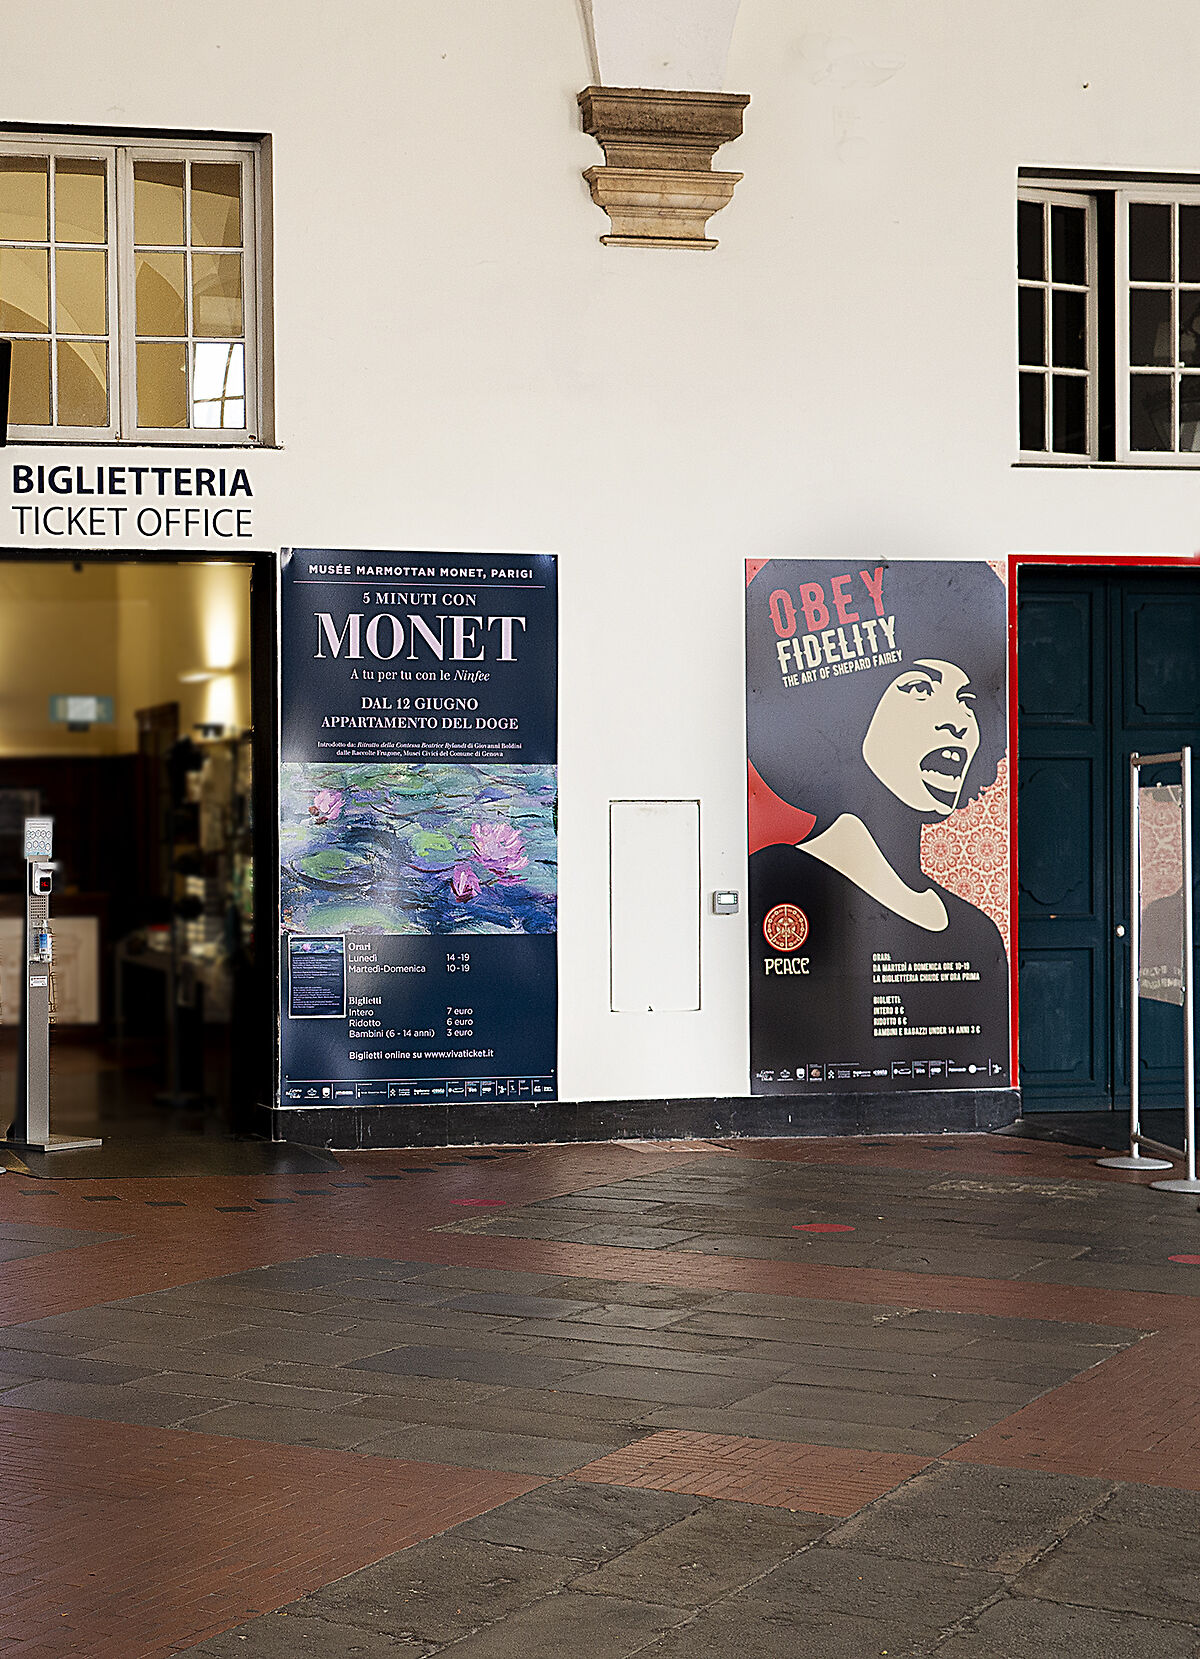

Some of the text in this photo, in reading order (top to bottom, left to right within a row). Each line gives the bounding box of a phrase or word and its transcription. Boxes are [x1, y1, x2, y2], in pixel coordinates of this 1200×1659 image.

[12, 464, 254, 497] BIGLIETTERIA
[11, 505, 253, 538] TICKET OFFICE
[308, 564, 533, 579] MUSÉE MARMOTTAN MONET, PARIGI
[363, 592, 477, 606] 5 MINUTI CON
[768, 567, 888, 639] OBEY
[313, 612, 526, 662] MONET
[776, 615, 897, 674] FIDELITY
[350, 669, 491, 683] A tu per tu con le Ninfee
[782, 650, 903, 688] THE ART OF SHEPARD FAIREY
[361, 696, 479, 711] DAL 12 GIUGNO
[321, 716, 519, 730] APPARTAMENTO DEL DOGE
[348, 943, 371, 952] Orari
[446, 953, 455, 962] 14
[764, 958, 810, 976] PEACE
[348, 996, 382, 1007] Biglietti
[349, 1008, 374, 1017] Intero
[446, 1007, 452, 1015] 7
[349, 1018, 381, 1028] Ridotto
[446, 1018, 452, 1026] 6
[349, 1029, 384, 1038] Bambini
[385, 1029, 396, 1038] (6
[403, 1029, 412, 1037] 14
[413, 1028, 435, 1038] anni)
[446, 1028, 452, 1036] 3
[349, 1050, 383, 1061] Biglietti
[385, 1050, 411, 1059] online
[423, 1048, 494, 1059] www.vivaticket.it
